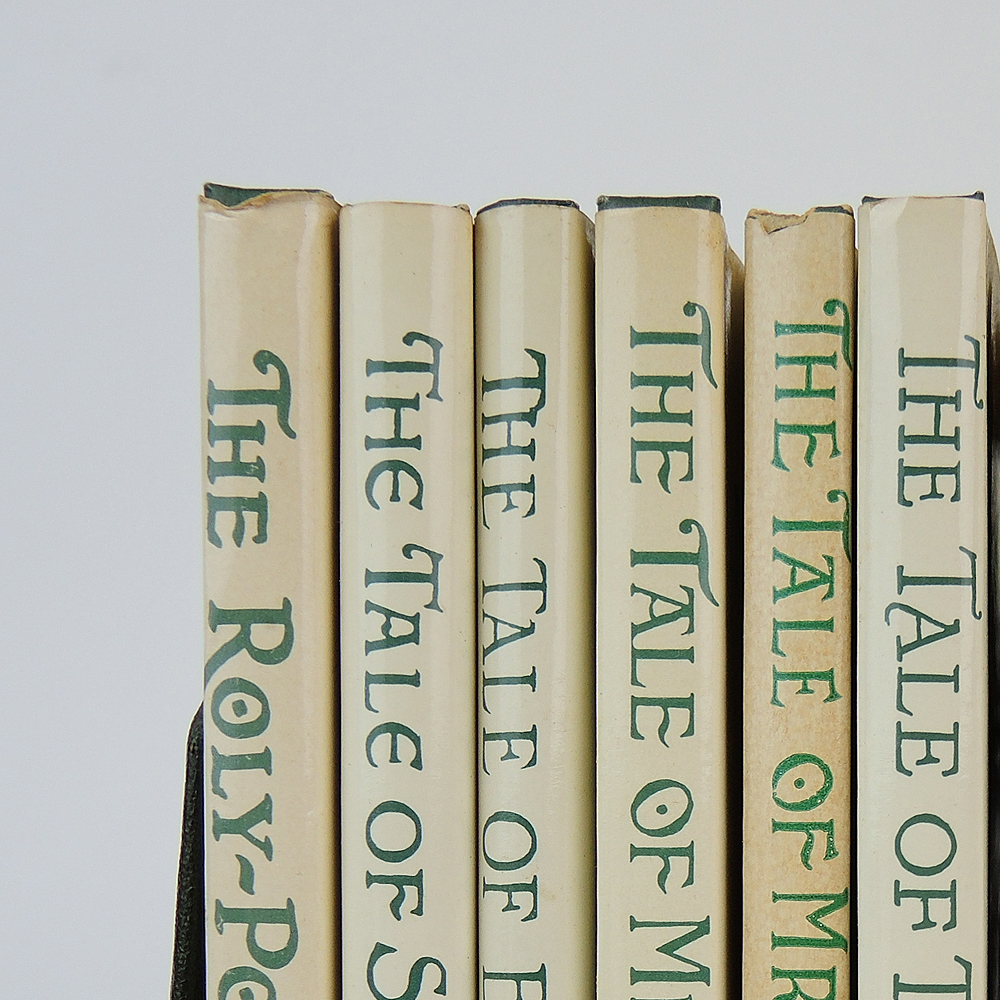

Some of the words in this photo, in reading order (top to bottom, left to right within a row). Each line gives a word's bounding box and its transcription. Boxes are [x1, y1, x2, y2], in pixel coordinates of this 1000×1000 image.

[207, 350, 295, 548] THE
[365, 332, 443, 510] THE
[481, 348, 546, 530] THE
[630, 301, 718, 494] THE
[772, 298, 850, 472] THE
[897, 335, 984, 507] THE
[365, 544, 443, 771] TALE
[482, 558, 547, 775] TALE
[630, 519, 719, 746] TALE
[771, 489, 850, 711] TALE
[885, 546, 983, 777] TALE
[366, 800, 423, 921] OF
[483, 811, 538, 921] OF
[630, 779, 694, 894] OF
[772, 753, 834, 870] OF
[894, 813, 957, 931] OF
